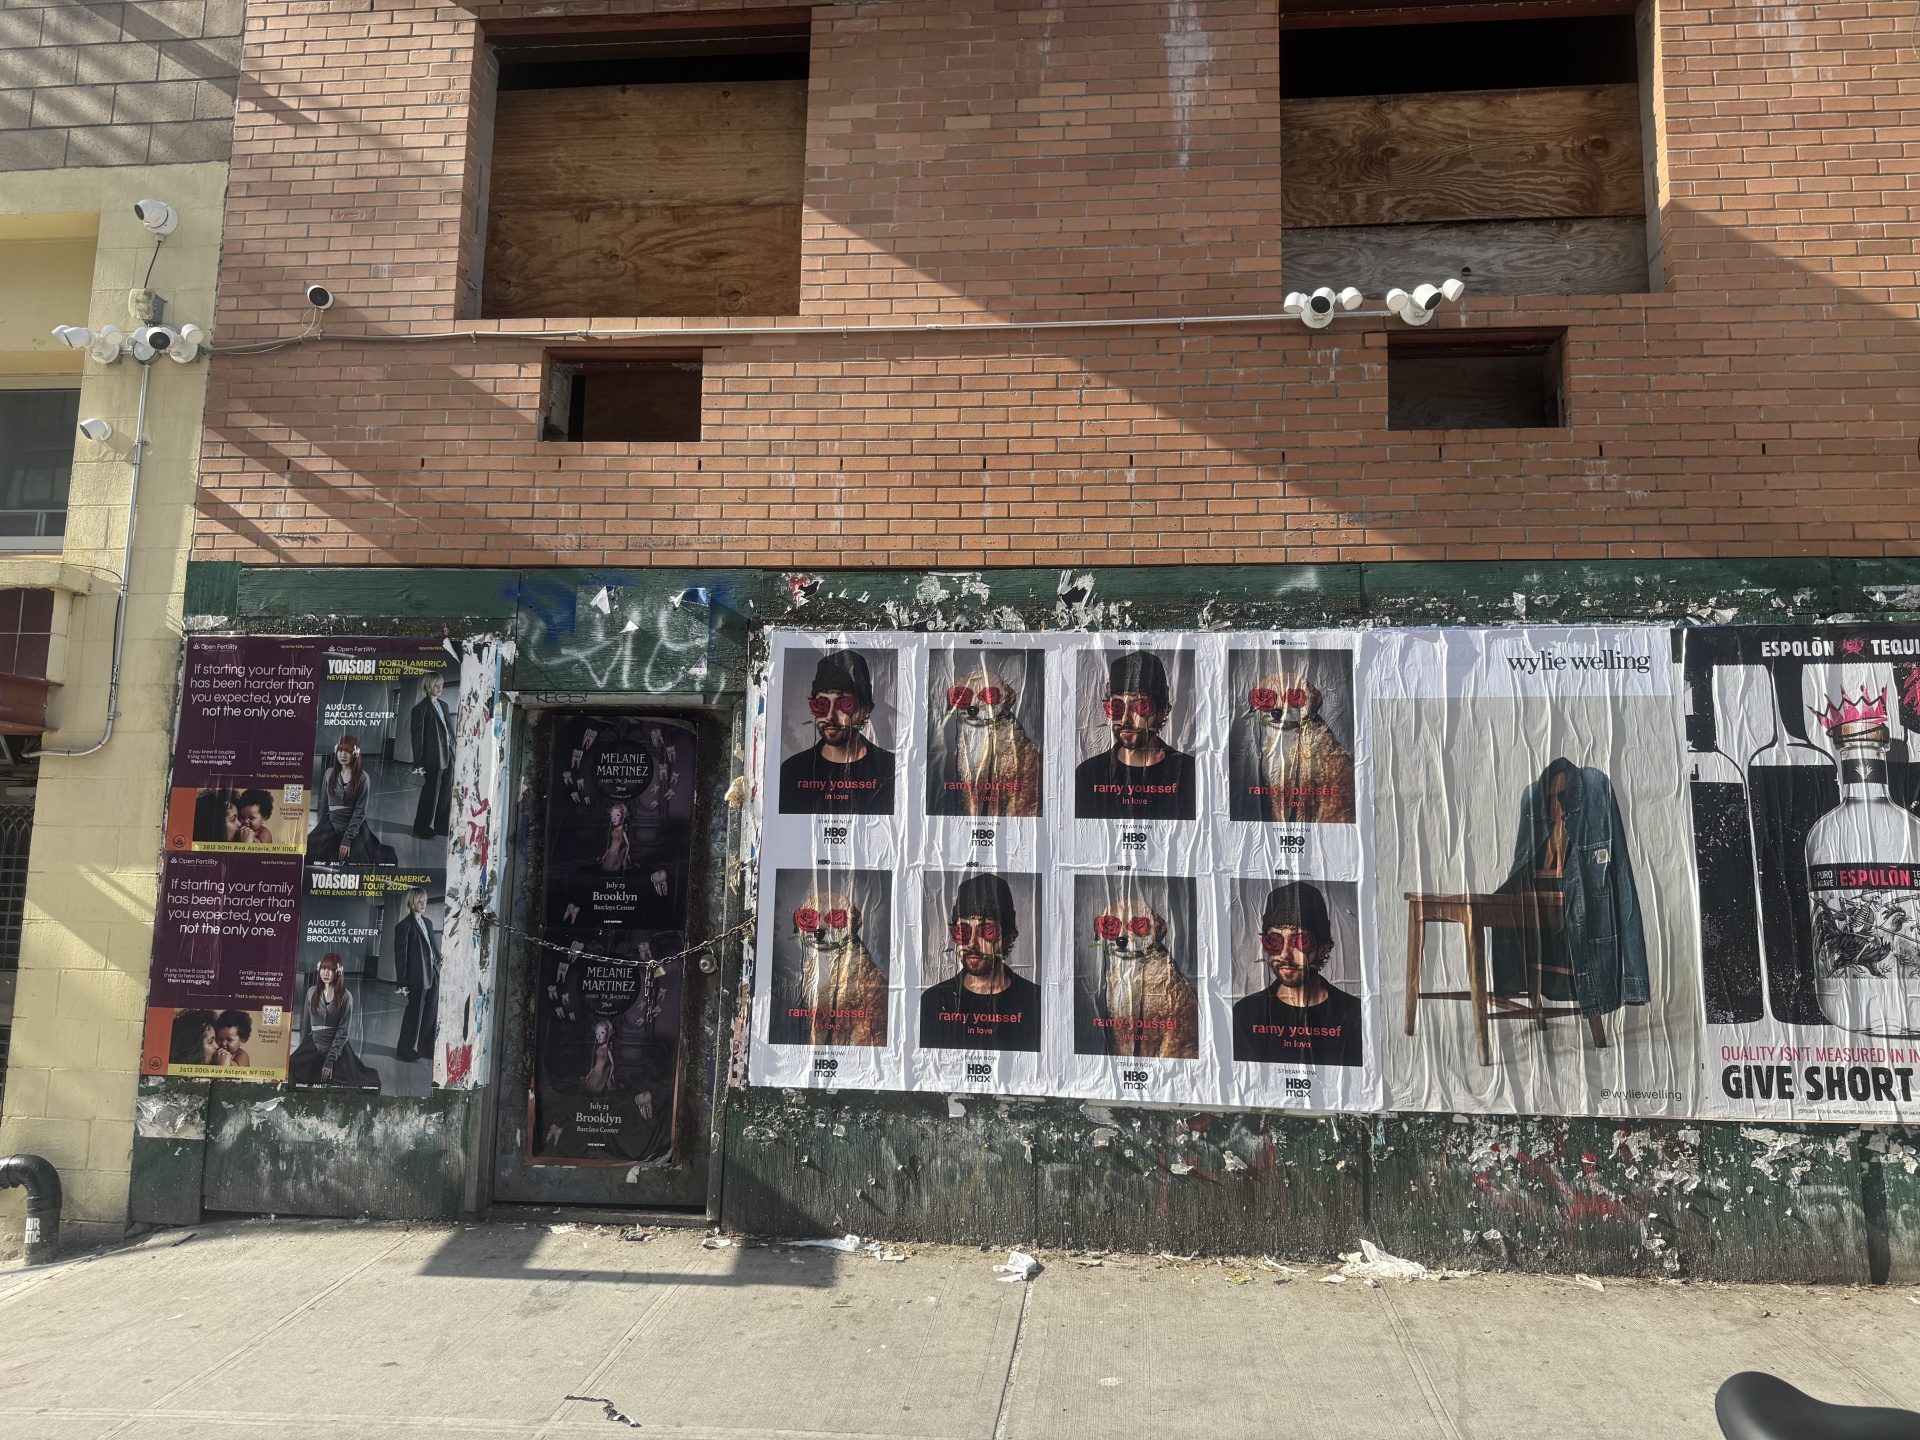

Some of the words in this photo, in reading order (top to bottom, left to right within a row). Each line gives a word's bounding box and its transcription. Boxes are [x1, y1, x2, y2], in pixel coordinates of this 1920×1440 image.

[201, 643, 216, 651] Open
[217, 643, 238, 651] Fertility
[329, 659, 375, 674] YOASOBI
[1507, 651, 1566, 674] wylie
[1570, 650, 1650, 673] welling
[194, 663, 200, 675] If
[203, 664, 245, 677] starting
[249, 667, 275, 677] your
[278, 665, 313, 679] family
[379, 667, 401, 675] TOUR
[191, 678, 210, 688] has
[213, 677, 241, 689] been
[244, 679, 285, 689] harder
[288, 678, 314, 690] than
[192, 694, 211, 704] you
[214, 692, 271, 705] expected,
[275, 693, 310, 706] you're
[203, 706, 220, 717] not
[224, 706, 241, 717] the
[244, 706, 269, 719] only
[272, 708, 296, 718] one.
[601, 753, 646, 763] MELANIE
[597, 766, 648, 776] MARTINEZ
[798, 779, 826, 790] ramy
[830, 779, 877, 790] youssef
[944, 780, 973, 791] ramy
[976, 781, 1024, 792] youssef
[1093, 784, 1124, 795] ramy
[1128, 783, 1176, 795] youssef
[1249, 786, 1279, 797] ramy
[1283, 786, 1335, 797] youssef
[1132, 797, 1147, 805] love
[824, 827, 847, 836] HBO
[972, 829, 994, 839] HBO
[972, 839, 993, 847] max
[1123, 832, 1147, 843] HBO
[1280, 836, 1305, 846] HBO
[1123, 842, 1146, 850] max
[393, 875, 431, 883] AMERICA
[1817, 870, 1832, 878] PURO
[312, 873, 359, 890] YOASOBI
[171, 879, 178, 890] If
[181, 879, 224, 893] starting
[228, 882, 256, 893] your
[258, 881, 294, 896] family
[167, 893, 188, 904] has
[191, 894, 221, 905] been
[223, 895, 264, 906] harder
[267, 896, 294, 908] than
[593, 892, 638, 903] Brooklyn
[168, 909, 189, 921] you
[192, 909, 251, 922] expected,
[254, 911, 291, 924] you're
[180, 924, 199, 933] not
[202, 923, 220, 934] the
[223, 924, 249, 938] only
[251, 926, 276, 937] one.
[307, 936, 350, 944] BROOKLYN,
[587, 967, 633, 978] MELANIE
[582, 980, 635, 991] MARTINEZ
[788, 1008, 817, 1019] ramy
[822, 1008, 870, 1019] youssef
[939, 1011, 969, 1023] ramy
[973, 1012, 1022, 1024] youssef
[1093, 1017, 1123, 1029] ramy
[1128, 1018, 1178, 1029] youssef
[977, 1027, 992, 1035] love
[1253, 1024, 1284, 1035] ramy
[1289, 1025, 1341, 1037] youssef
[1284, 1040, 1291, 1048] in
[1722, 1046, 1775, 1062] QUALITY
[1780, 1046, 1810, 1062] ISN'T
[1816, 1047, 1885, 1063] MEASURED
[1891, 1048, 1904, 1063] IN
[815, 1059, 837, 1069] HBO
[968, 1064, 991, 1074] HBO
[814, 1070, 836, 1078] max
[968, 1075, 990, 1083] max
[1124, 1071, 1148, 1081] HBO
[1124, 1082, 1147, 1090] max
[1286, 1078, 1311, 1088] HBO
[1722, 1065, 1794, 1099] GIVE
[1804, 1066, 1913, 1101] SHORT
[1286, 1089, 1310, 1098] max
[1601, 1089, 1681, 1101] @wyliewelling
[590, 1103, 602, 1111] July
[576, 1112, 621, 1125] Brooklyn
